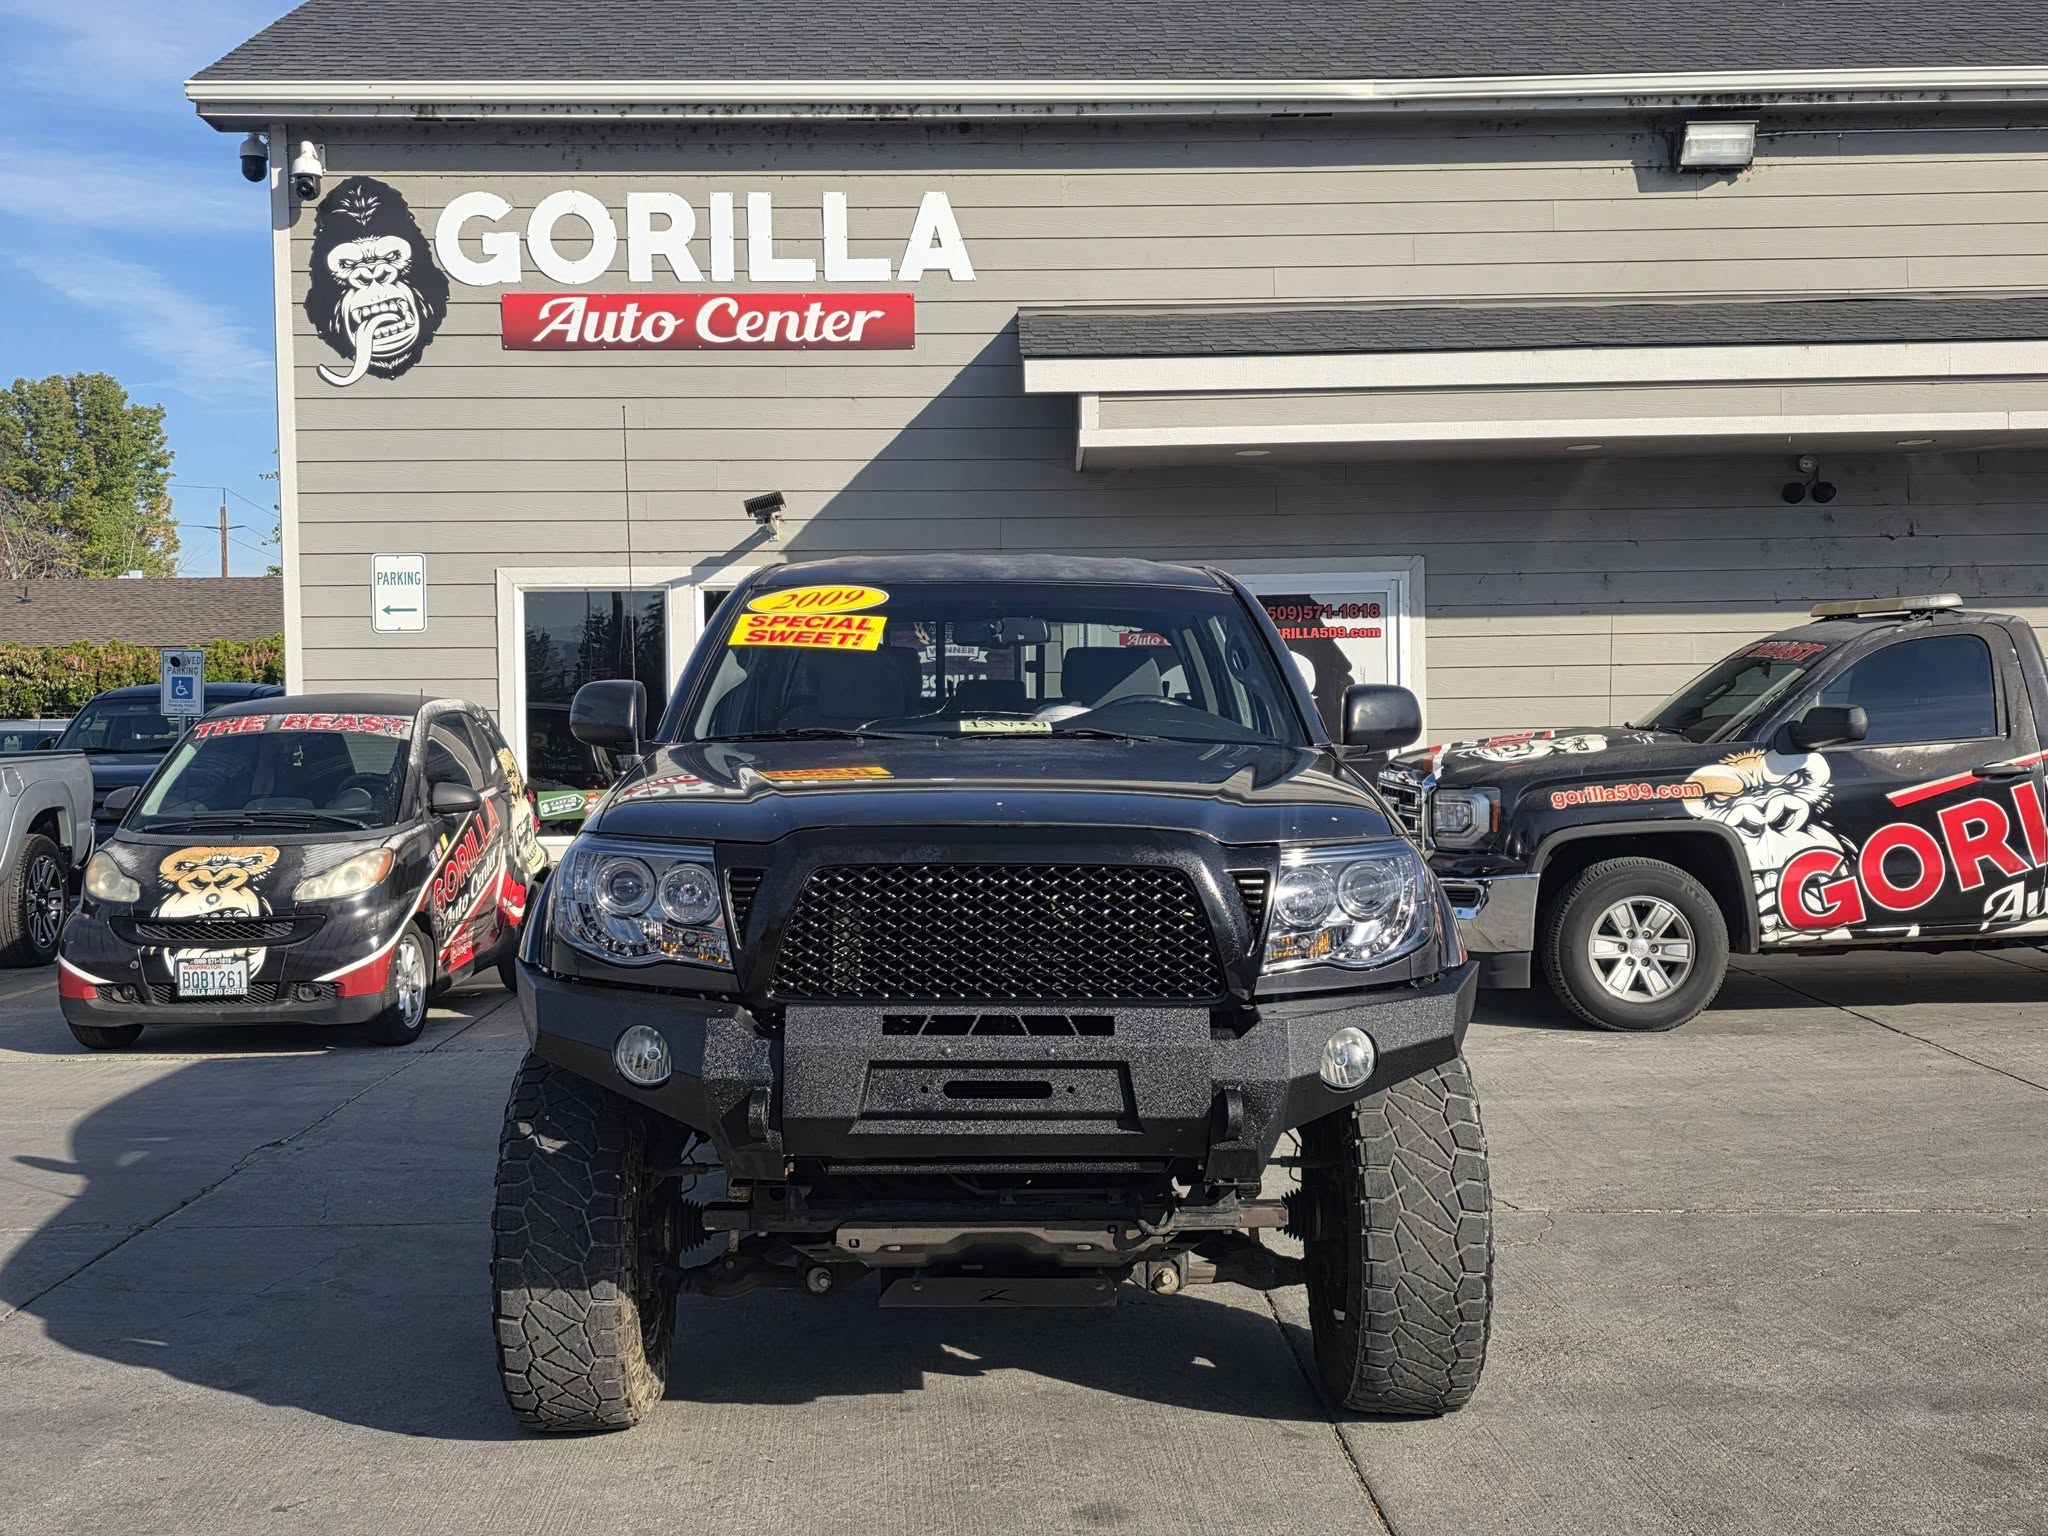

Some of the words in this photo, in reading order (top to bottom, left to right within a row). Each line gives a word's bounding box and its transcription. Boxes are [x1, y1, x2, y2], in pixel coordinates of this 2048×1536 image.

[436, 190, 976, 285] GORILLA
[532, 296, 684, 344] Auto
[695, 296, 886, 344] Center
[377, 571, 421, 586] PARKING
[770, 589, 865, 610] 2009
[1267, 603, 1381, 622] 509)571-1818
[747, 615, 874, 631] SPECIAL
[744, 629, 866, 647] SWEET!
[1127, 633, 1161, 646] Auto
[1278, 626, 1381, 639] RILLA509.com
[928, 646, 975, 655] WNNER
[164, 655, 201, 665] RVED
[167, 666, 199, 676] PARKING
[194, 714, 271, 739] THE
[280, 713, 412, 735] BEAST
[1551, 783, 1702, 809] gorilla509.com
[433, 796, 501, 914] GORILLA
[1778, 777, 2048, 931] GORI
[182, 970, 243, 989] BQB1261
[180, 988, 206, 997] GORILLA
[206, 988, 223, 996] AUTO
[223, 987, 248, 996] CENTER
